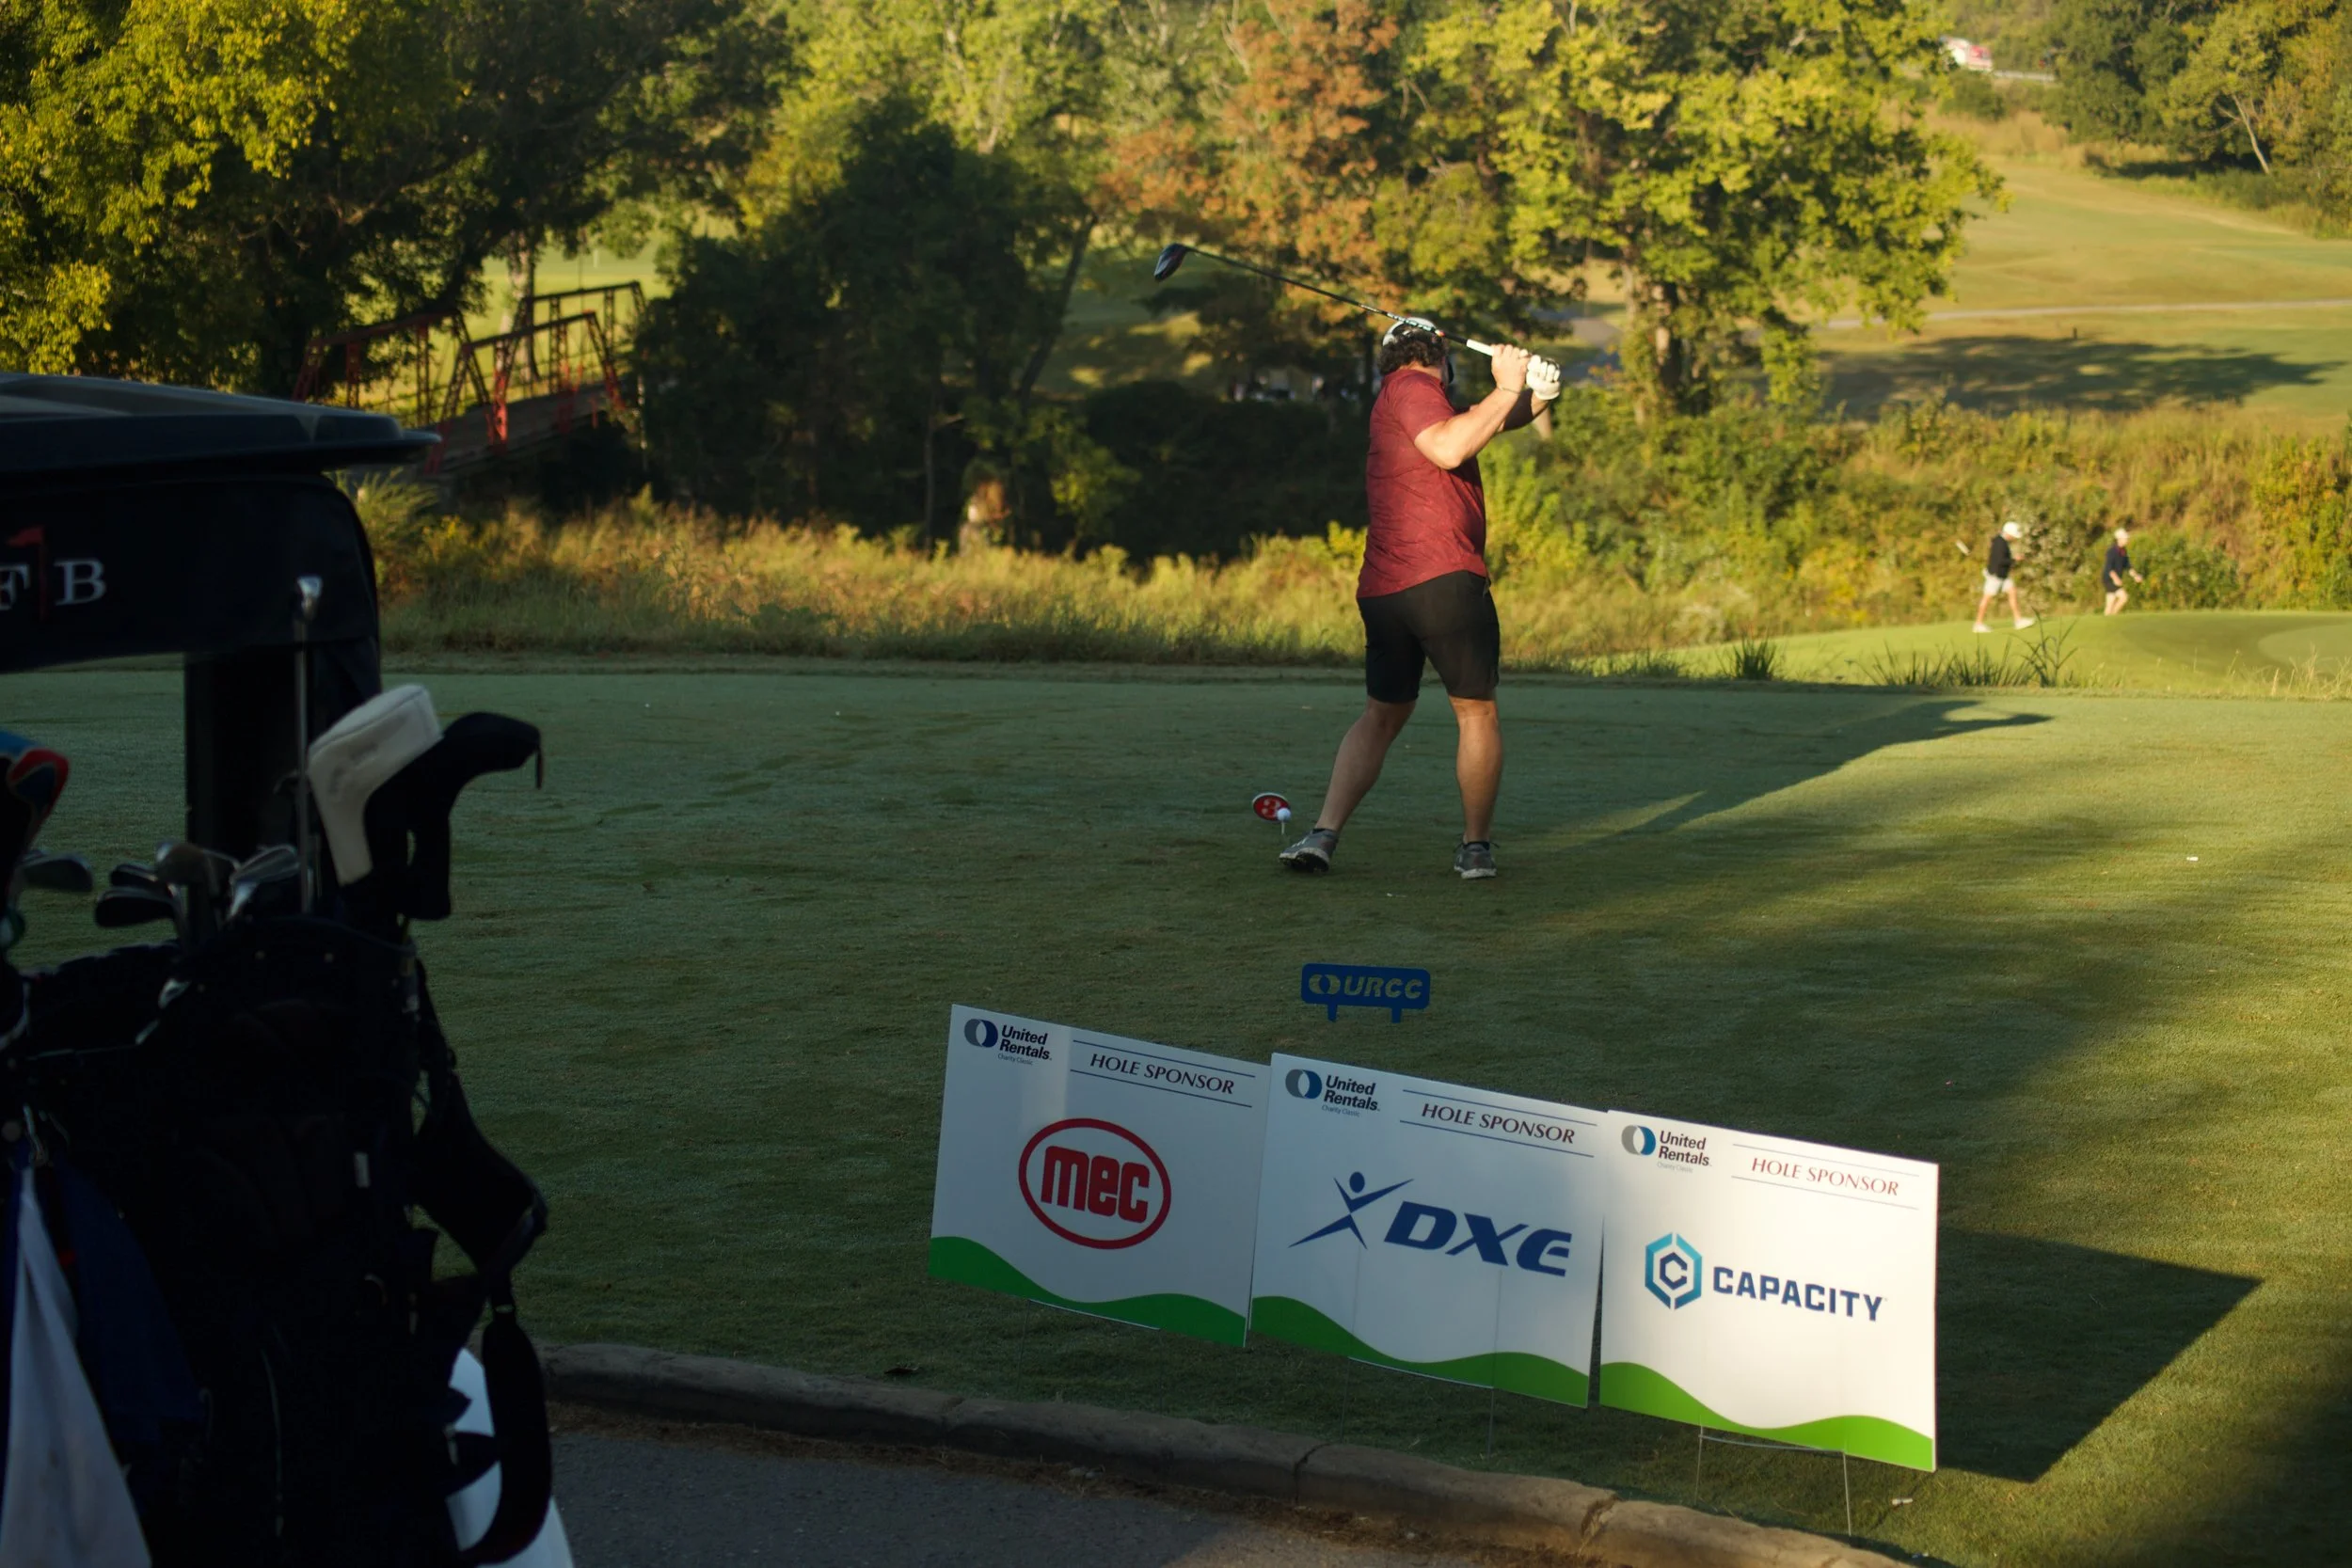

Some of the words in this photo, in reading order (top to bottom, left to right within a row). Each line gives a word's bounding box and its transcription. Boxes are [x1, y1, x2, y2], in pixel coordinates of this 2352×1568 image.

[1343, 975, 1423, 999] URCC
[1001, 1024, 1048, 1046] United
[999, 1037, 1051, 1060] Rentals
[1089, 1053, 1139, 1075] HOLE
[1144, 1064, 1235, 1094] SPONSOR
[1326, 1074, 1376, 1096] United
[1324, 1089, 1378, 1112] Rentals
[1422, 1102, 1474, 1127] HOLE
[1479, 1113, 1576, 1145] SPONSOR
[1659, 1130, 1707, 1150] United
[1658, 1146, 1710, 1167] Rentals
[1751, 1156, 1802, 1180] HOLE
[1806, 1165, 1899, 1196] SPONSOR
[1384, 1200, 1573, 1277] DXE
[1713, 1265, 1883, 1322] CAPACITY
